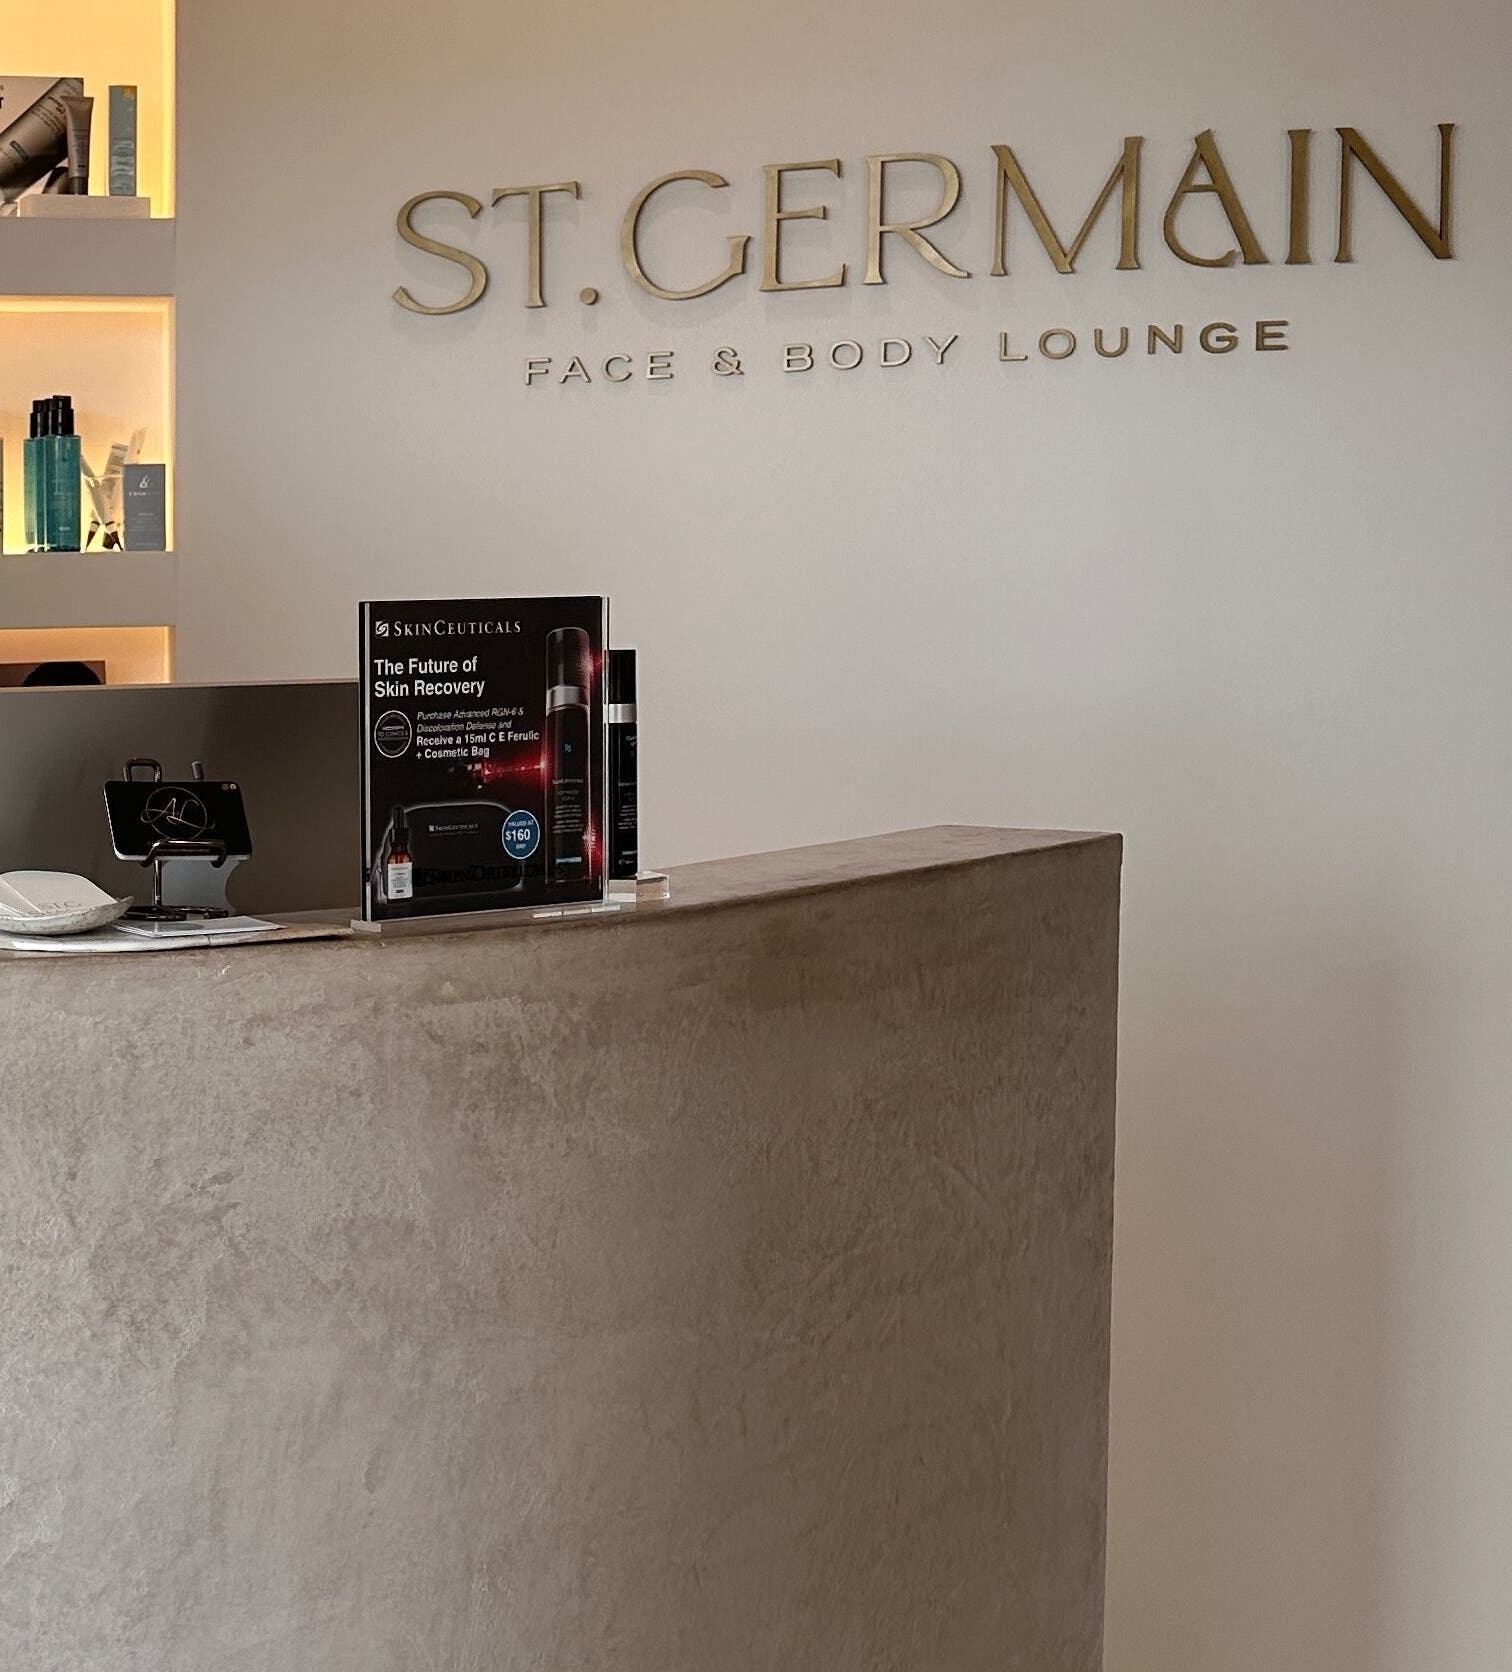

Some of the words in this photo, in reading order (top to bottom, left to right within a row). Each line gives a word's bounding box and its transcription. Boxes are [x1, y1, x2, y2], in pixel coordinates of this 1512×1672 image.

[523, 350, 675, 387] FACE
[710, 347, 745, 378] &
[781, 333, 962, 374] BODY
[999, 318, 1292, 364] LOUNGE
[393, 619, 522, 637] SKINCEUTICALS
[373, 658, 405, 676] The
[408, 657, 459, 675] Future
[462, 655, 478, 672] of
[374, 680, 410, 698] Skin
[414, 679, 486, 698] Recovery
[417, 711, 452, 720] Purchase
[498, 719, 513, 729] and
[416, 735, 454, 746] Receive
[456, 736, 462, 745] a
[464, 732, 487, 744] 15ml
[488, 732, 496, 743] C
[498, 731, 506, 742] E
[507, 730, 540, 742] Ferulic
[424, 747, 469, 759] Cosmetic
[471, 745, 490, 758] Bag
[504, 828, 531, 842] $160
